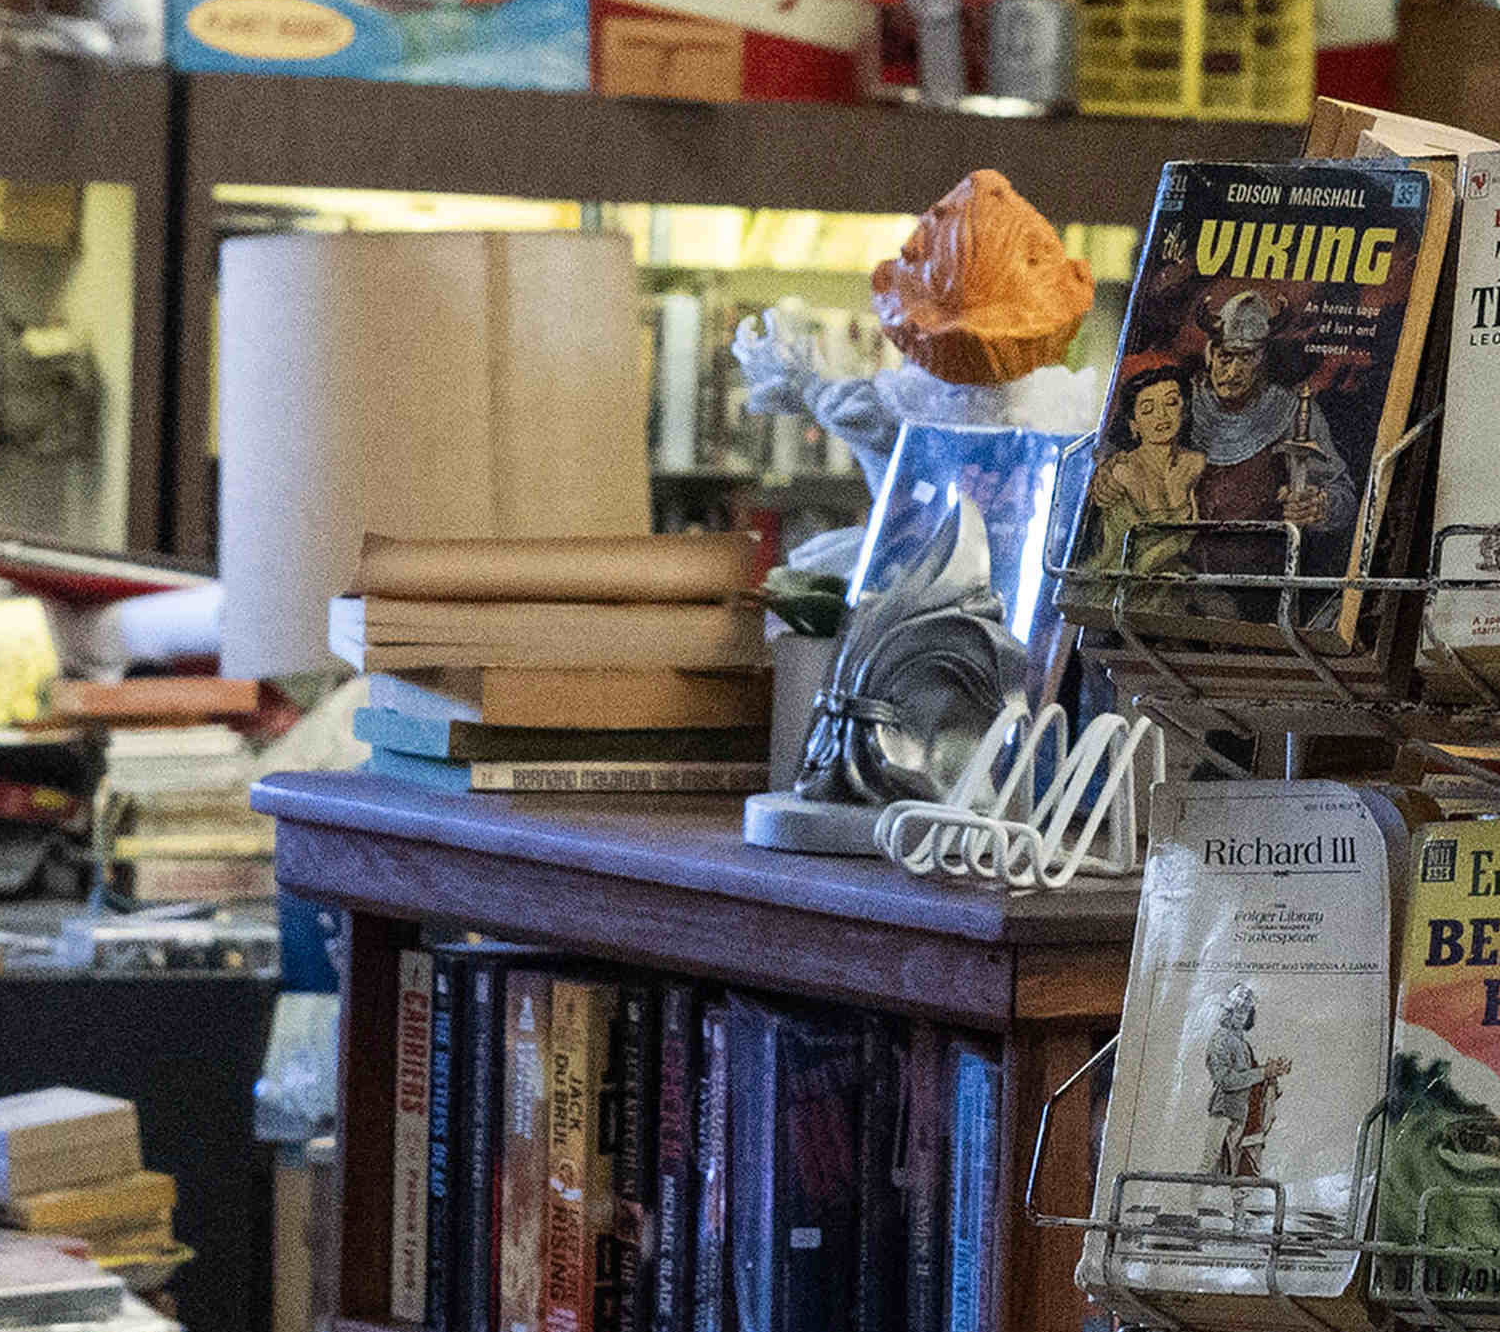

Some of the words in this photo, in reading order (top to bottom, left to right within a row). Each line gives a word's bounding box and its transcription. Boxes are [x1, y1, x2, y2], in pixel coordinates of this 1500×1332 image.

[1226, 183, 1283, 206] EDISON
[1290, 186, 1366, 210] MARSHALL
[1195, 218, 1398, 287] VIKING
[1203, 836, 1325, 867] Richard
[1331, 836, 1357, 865] III
[399, 990, 428, 1117] CARRIERS
[551, 1091, 568, 1146] BRUL
[568, 1075, 582, 1130] JACK
[658, 1174, 675, 1254] MICHAEL
[548, 1203, 566, 1302] RISING
[657, 1257, 673, 1317] SLADE
